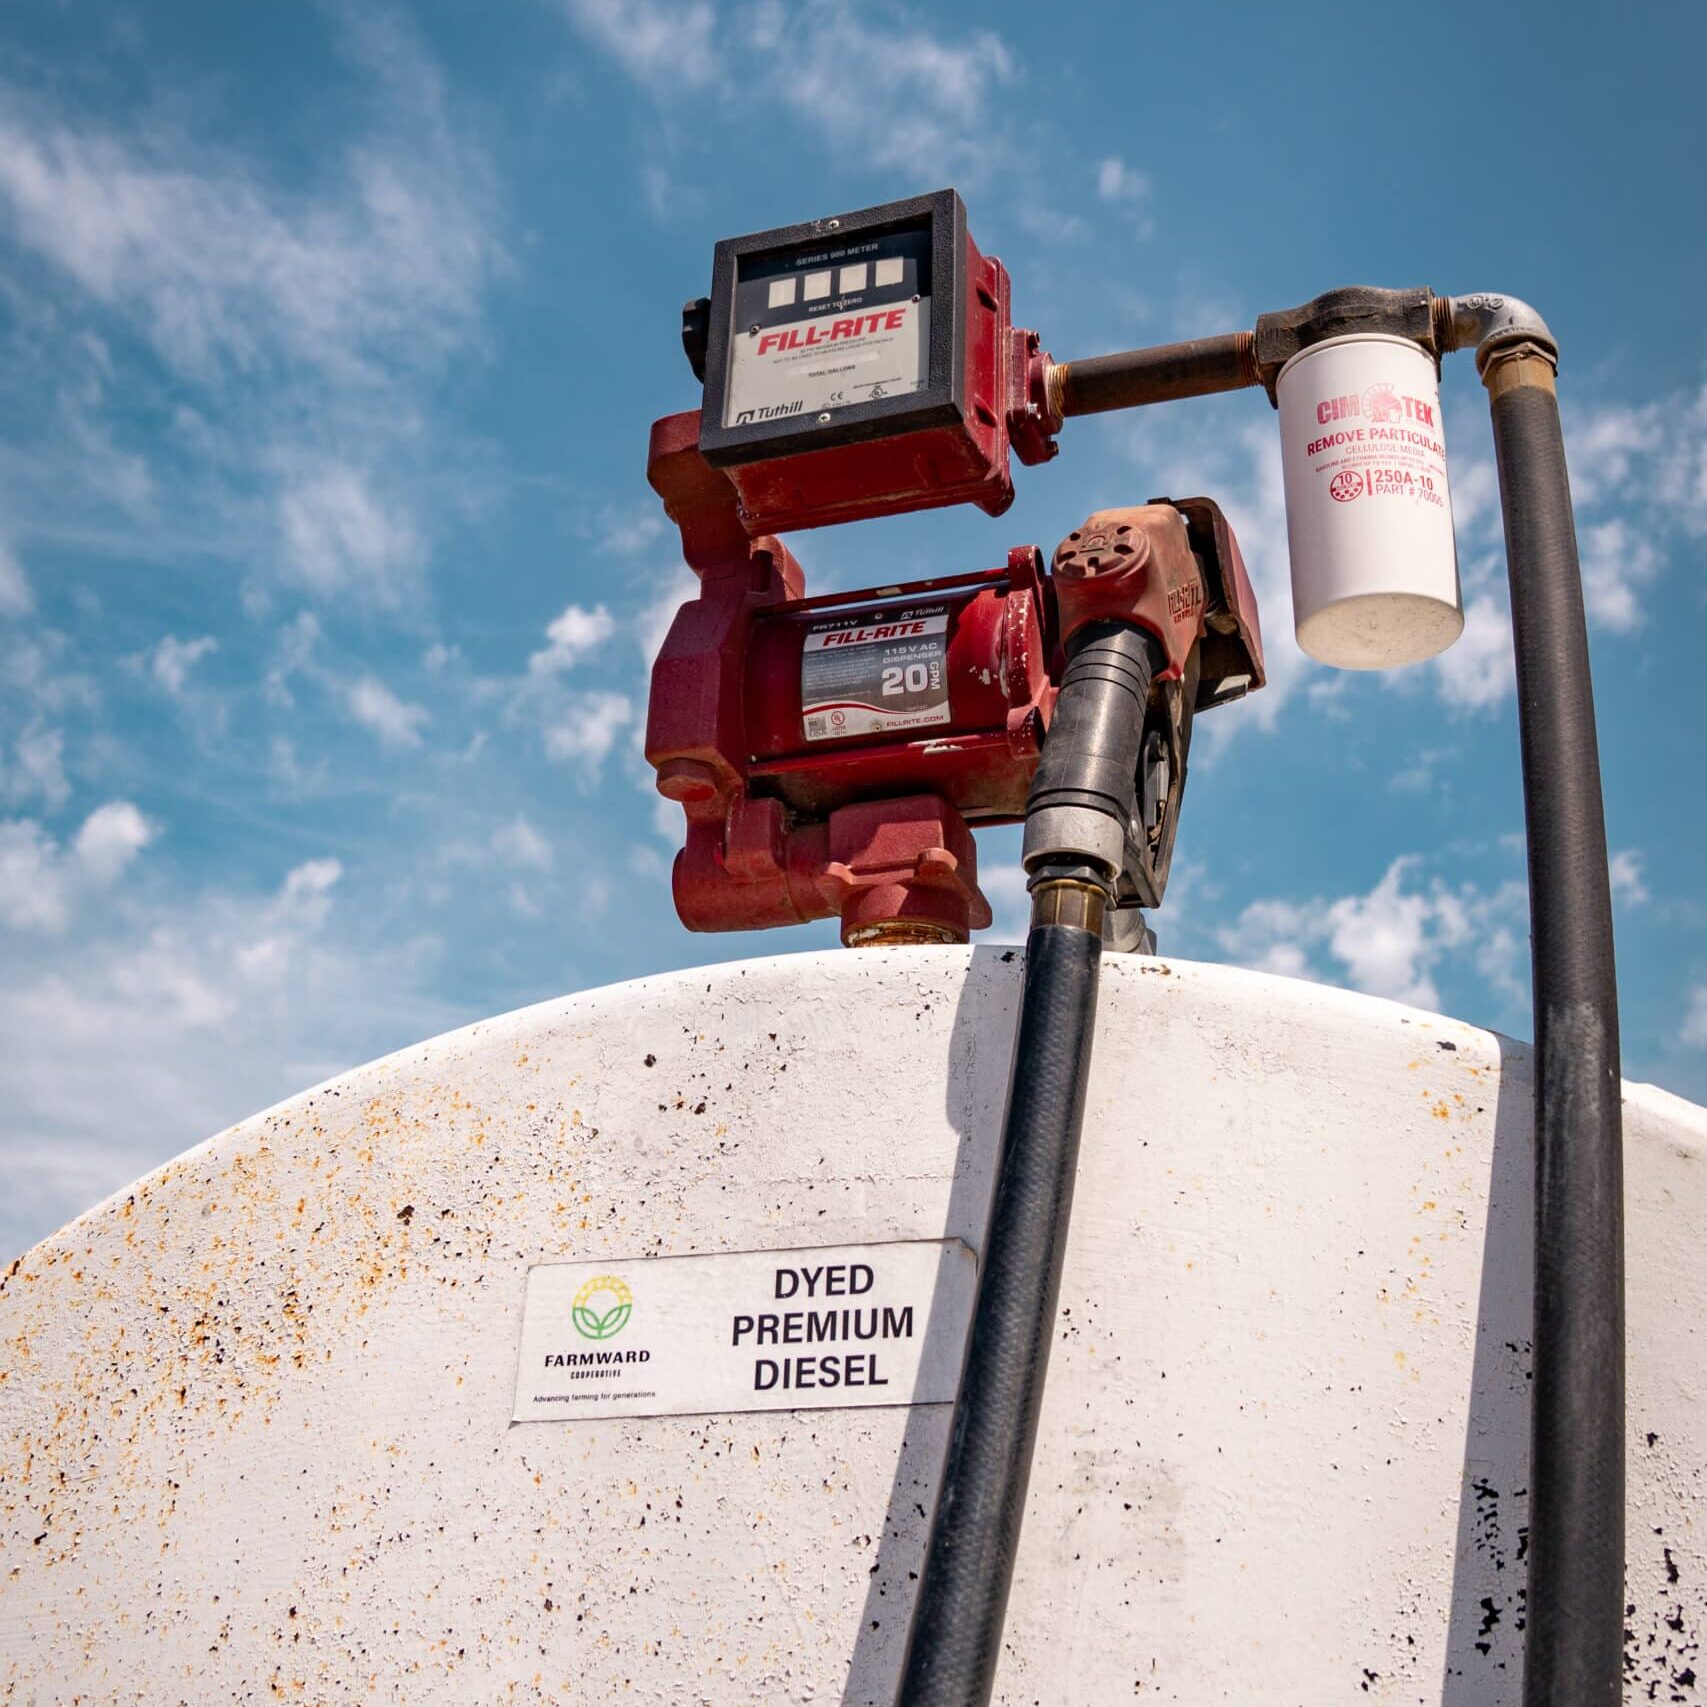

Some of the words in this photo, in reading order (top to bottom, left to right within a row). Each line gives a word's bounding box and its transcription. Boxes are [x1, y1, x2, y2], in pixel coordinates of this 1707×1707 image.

[795, 253, 829, 267] SERIES
[847, 242, 879, 255] METER
[808, 302, 831, 312] RESET
[843, 297, 863, 306] ZERO
[757, 308, 907, 357] FILL-RITE
[808, 370, 827, 379] TOTAL
[757, 400, 804, 419] Tuthill
[1401, 395, 1434, 428] TEK
[1307, 428, 1365, 457] REMOVE
[1345, 443, 1398, 455] CELLULOSE
[1401, 444, 1425, 457] MEDIA
[1339, 473, 1353, 486] 10
[1374, 469, 1434, 491] 250A-10
[1375, 484, 1405, 495] PART
[823, 621, 927, 647] FILL-RITE
[883, 650, 942, 664] DISPENSER
[882, 663, 929, 696] 20
[930, 661, 941, 690] GPM
[886, 715, 944, 728] FILLRITE.COM
[774, 1264, 875, 1300] DYED
[732, 1306, 913, 1346] PREMIUM
[544, 1350, 651, 1367] FARMWARD
[570, 1369, 622, 1380] COOPERATIVE
[754, 1353, 889, 1391] DIESEL
[533, 1395, 570, 1403] Advancing
[571, 1393, 599, 1402] farming
[600, 1392, 611, 1400] for
[612, 1391, 656, 1402] generations
